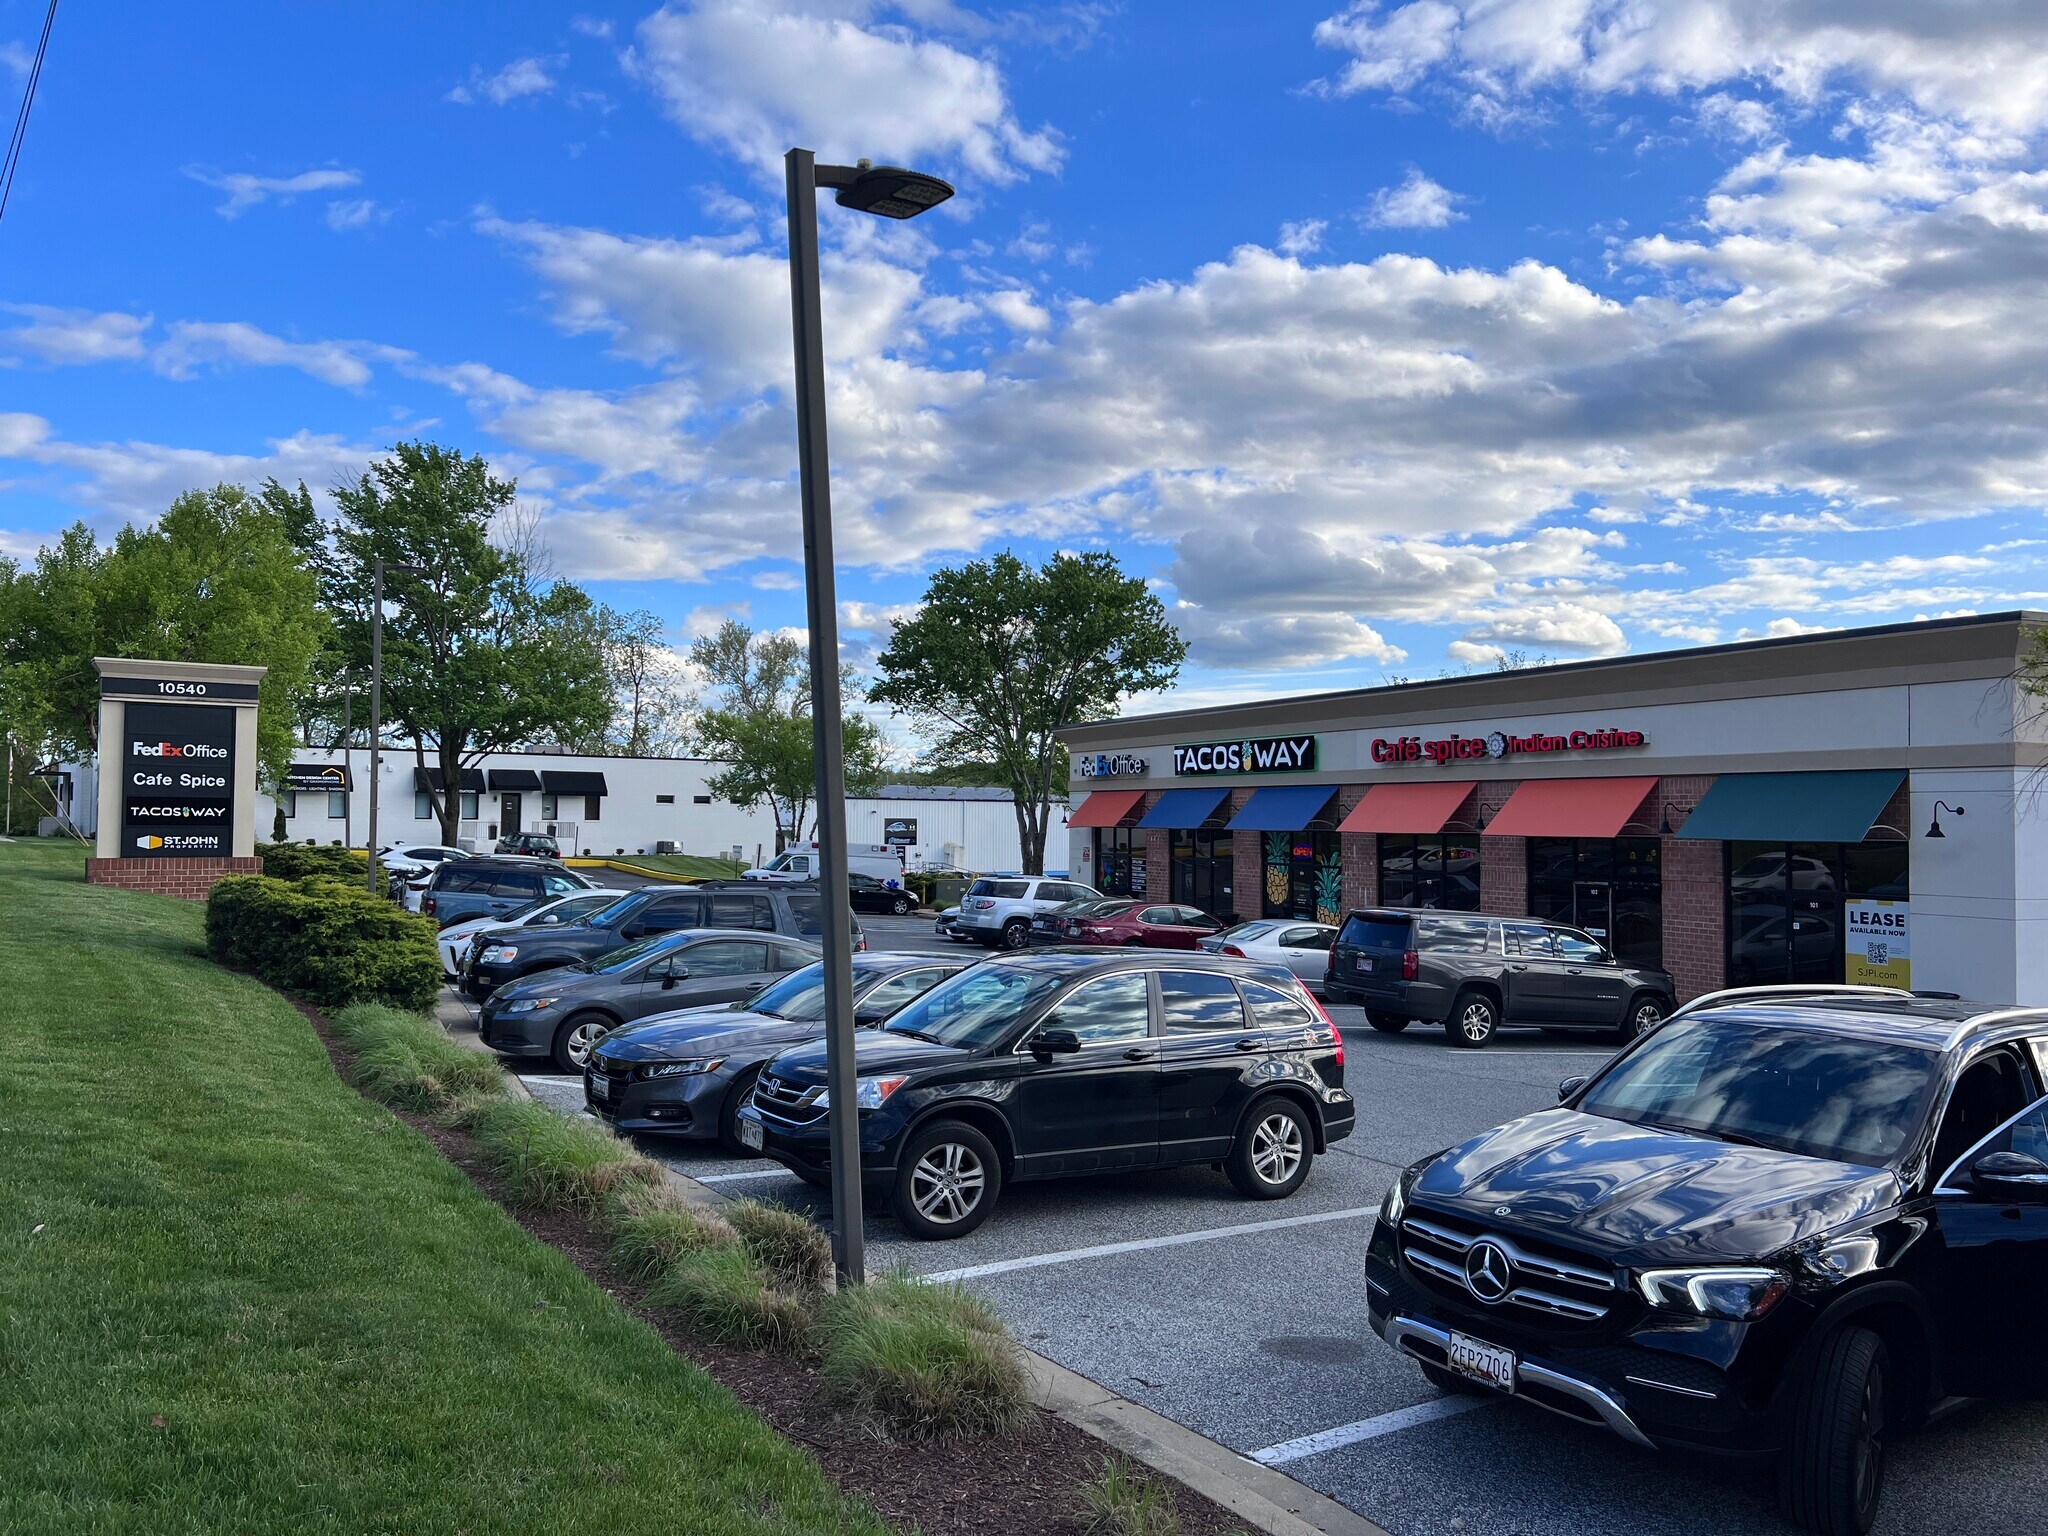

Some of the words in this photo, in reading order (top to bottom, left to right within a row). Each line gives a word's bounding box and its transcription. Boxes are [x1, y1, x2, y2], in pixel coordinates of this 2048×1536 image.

[158, 682, 207, 695] 10540
[133, 741, 182, 757] FedEx
[183, 744, 228, 758] Office
[1371, 737, 1420, 763] Café
[1424, 735, 1484, 765] spice
[1508, 734, 1563, 753] Indian
[1569, 728, 1642, 750] Cuisine
[1174, 745, 1240, 772] TACOS
[1254, 739, 1310, 768] WAY
[133, 772, 173, 786] Cafe
[180, 773, 226, 789] Spice
[131, 806, 182, 816] TACOS
[191, 807, 226, 817] WAY
[1850, 910, 1905, 928] LEASE
[1850, 926, 1887, 936] AVAILABLE
[1888, 929, 1906, 937] NOW
[1857, 967, 1898, 980] SJPI.com
[1451, 1343, 1509, 1382] 2EP2706
